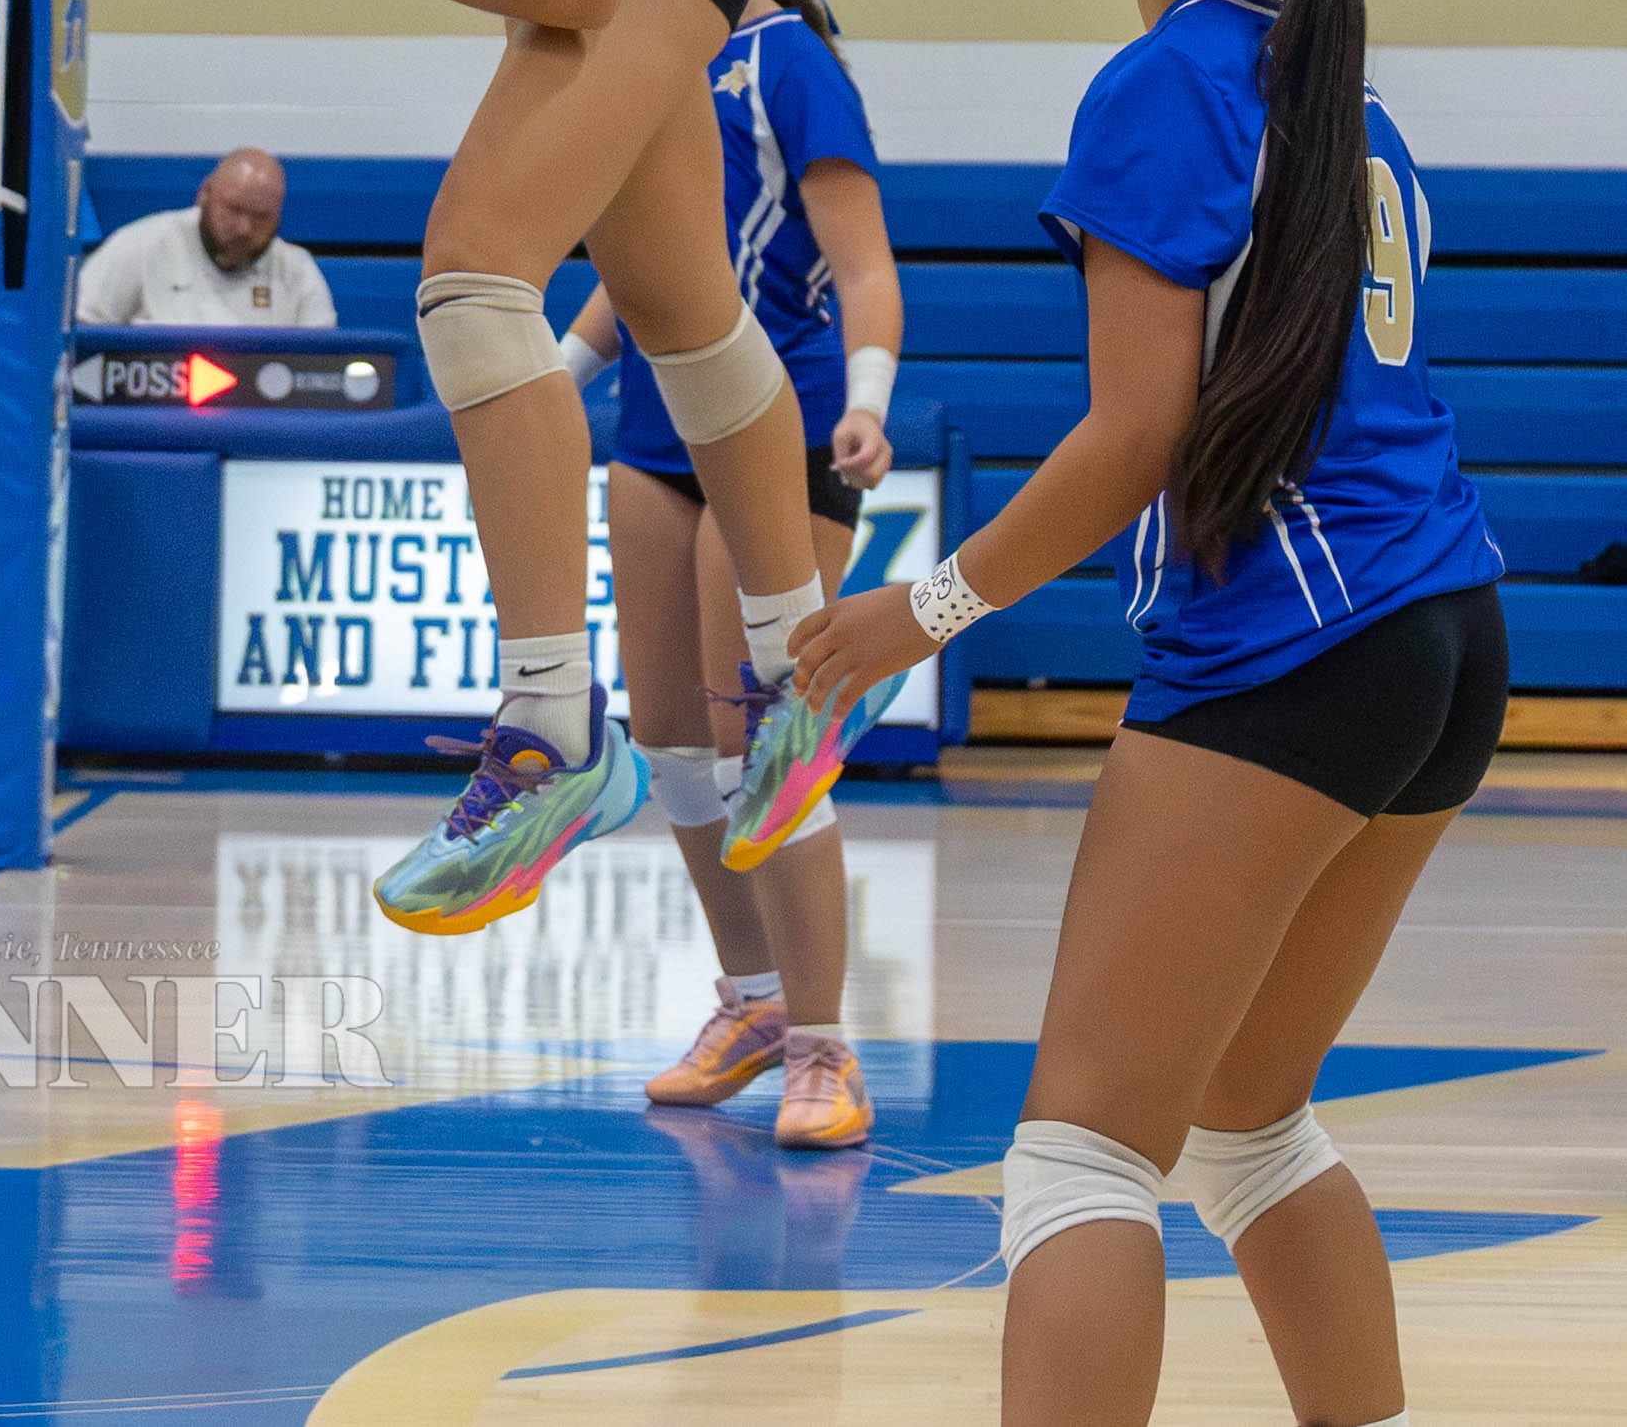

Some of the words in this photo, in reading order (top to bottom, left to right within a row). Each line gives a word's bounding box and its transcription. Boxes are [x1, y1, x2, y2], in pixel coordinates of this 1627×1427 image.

[1363, 156, 1415, 367] 9
[104, 359, 191, 399] POSS
[321, 477, 443, 522] HOME
[238, 614, 373, 687] AND
